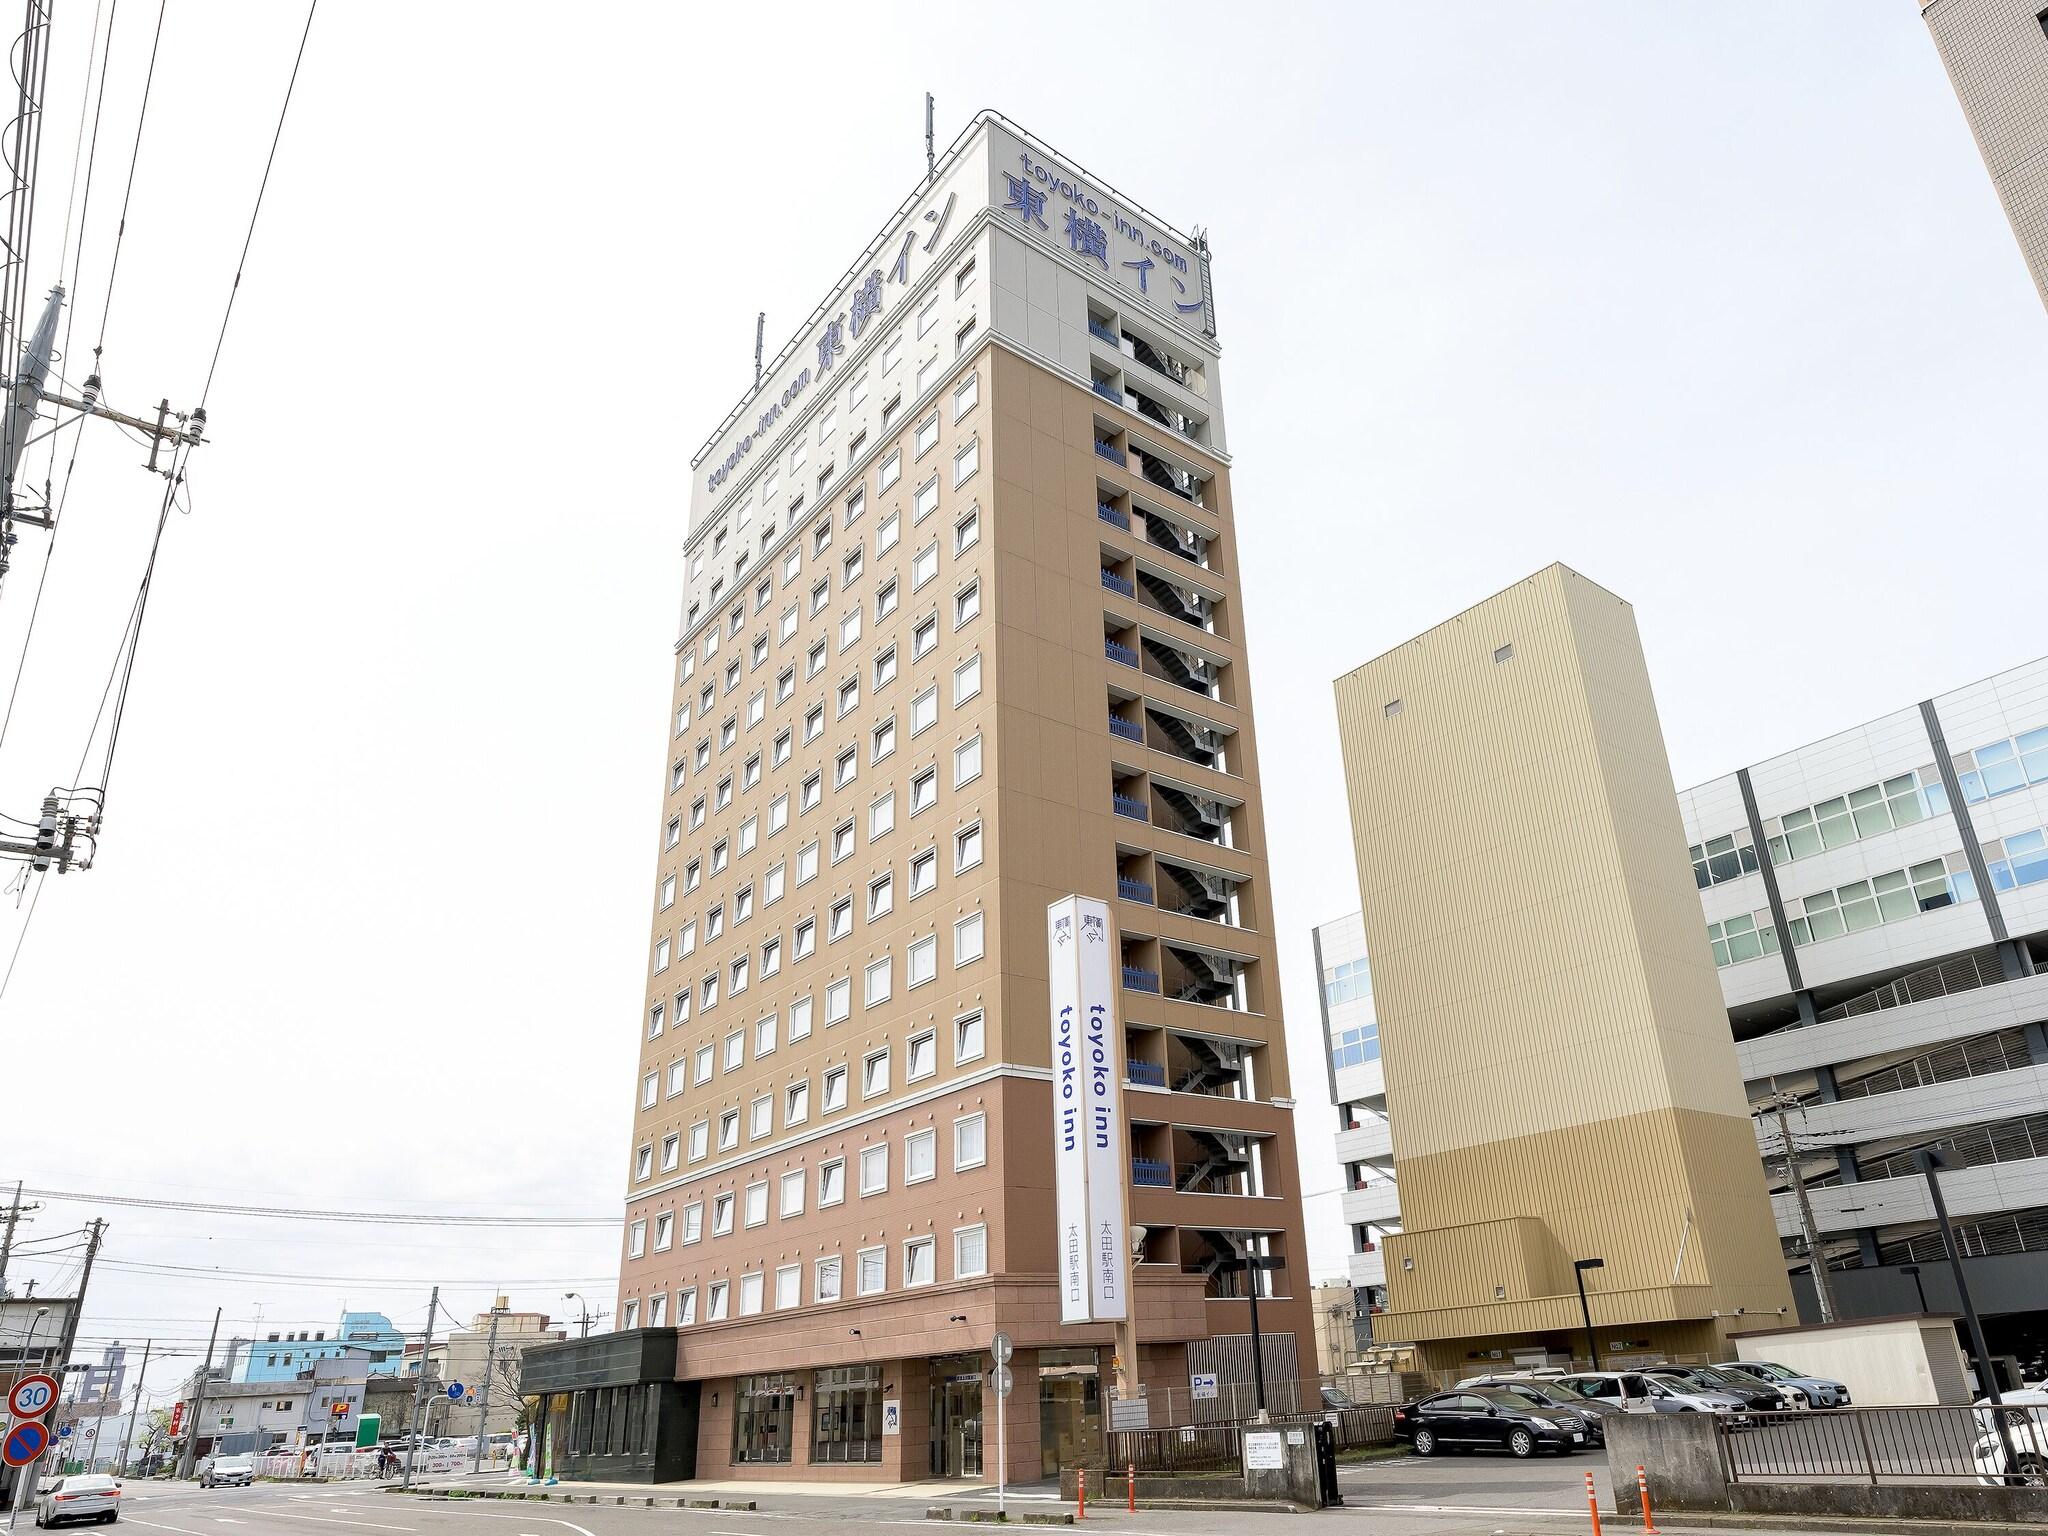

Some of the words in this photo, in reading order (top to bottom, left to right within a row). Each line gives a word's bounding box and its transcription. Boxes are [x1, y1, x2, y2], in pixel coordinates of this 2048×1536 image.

[1001, 169, 1205, 314] 東横イン
[1020, 153, 1188, 273] toyoko-inn.com
[814, 191, 958, 384] 東横イン
[707, 367, 812, 493] toyoko-inn.com
[1058, 1005, 1076, 1099] toyoko
[1087, 1004, 1109, 1097] toyoko
[1063, 1107, 1077, 1152] inn
[1095, 1106, 1111, 1149] inn
[1068, 1222, 1080, 1302] 太田駅南口
[1100, 1219, 1115, 1300] 太田駅南口
[19, 1387, 48, 1407] 30
[335, 1404, 348, 1412] P
[1194, 1377, 1202, 1390] P
